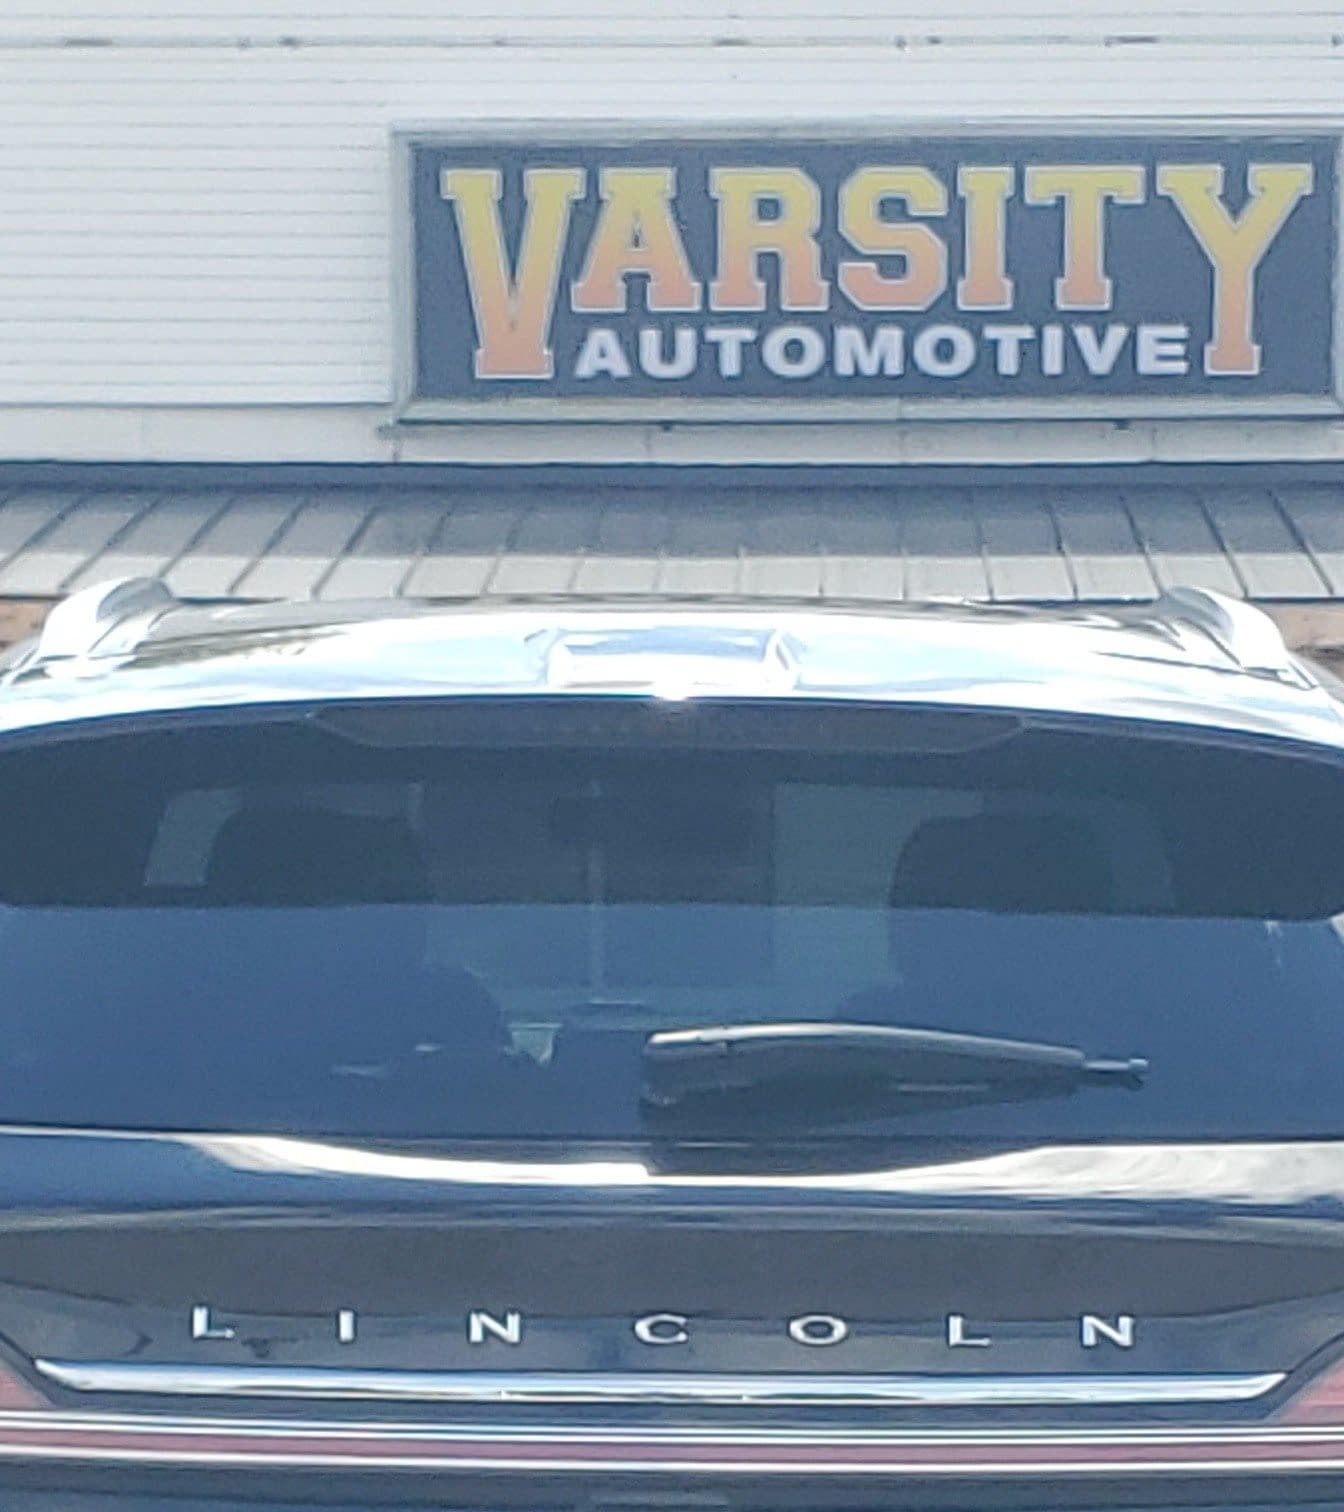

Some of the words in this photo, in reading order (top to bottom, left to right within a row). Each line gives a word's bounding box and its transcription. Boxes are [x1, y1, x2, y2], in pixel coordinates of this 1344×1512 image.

[441, 163, 1313, 381] VARSITY
[573, 325, 1192, 380] AUTOMOTIVE
[191, 1304, 1137, 1349] LINCOLN
